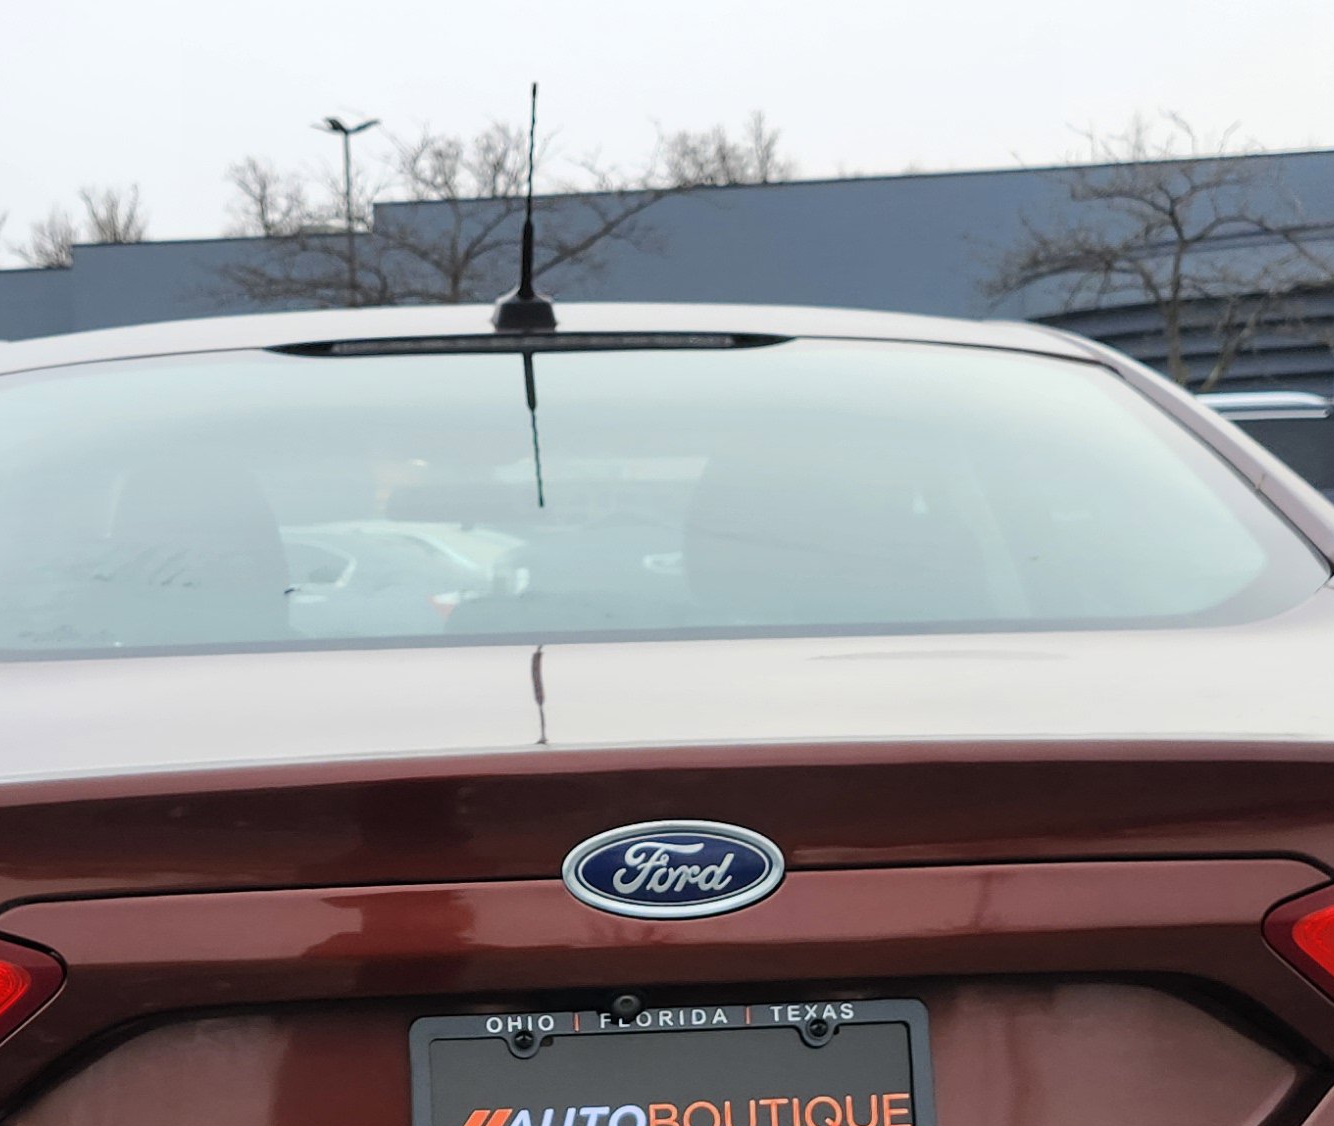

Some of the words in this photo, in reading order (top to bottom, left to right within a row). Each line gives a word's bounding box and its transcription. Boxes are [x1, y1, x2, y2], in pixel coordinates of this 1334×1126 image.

[612, 841, 734, 894] Ford
[486, 1014, 555, 1033] OHIO
[770, 1002, 856, 1022] TEXAS
